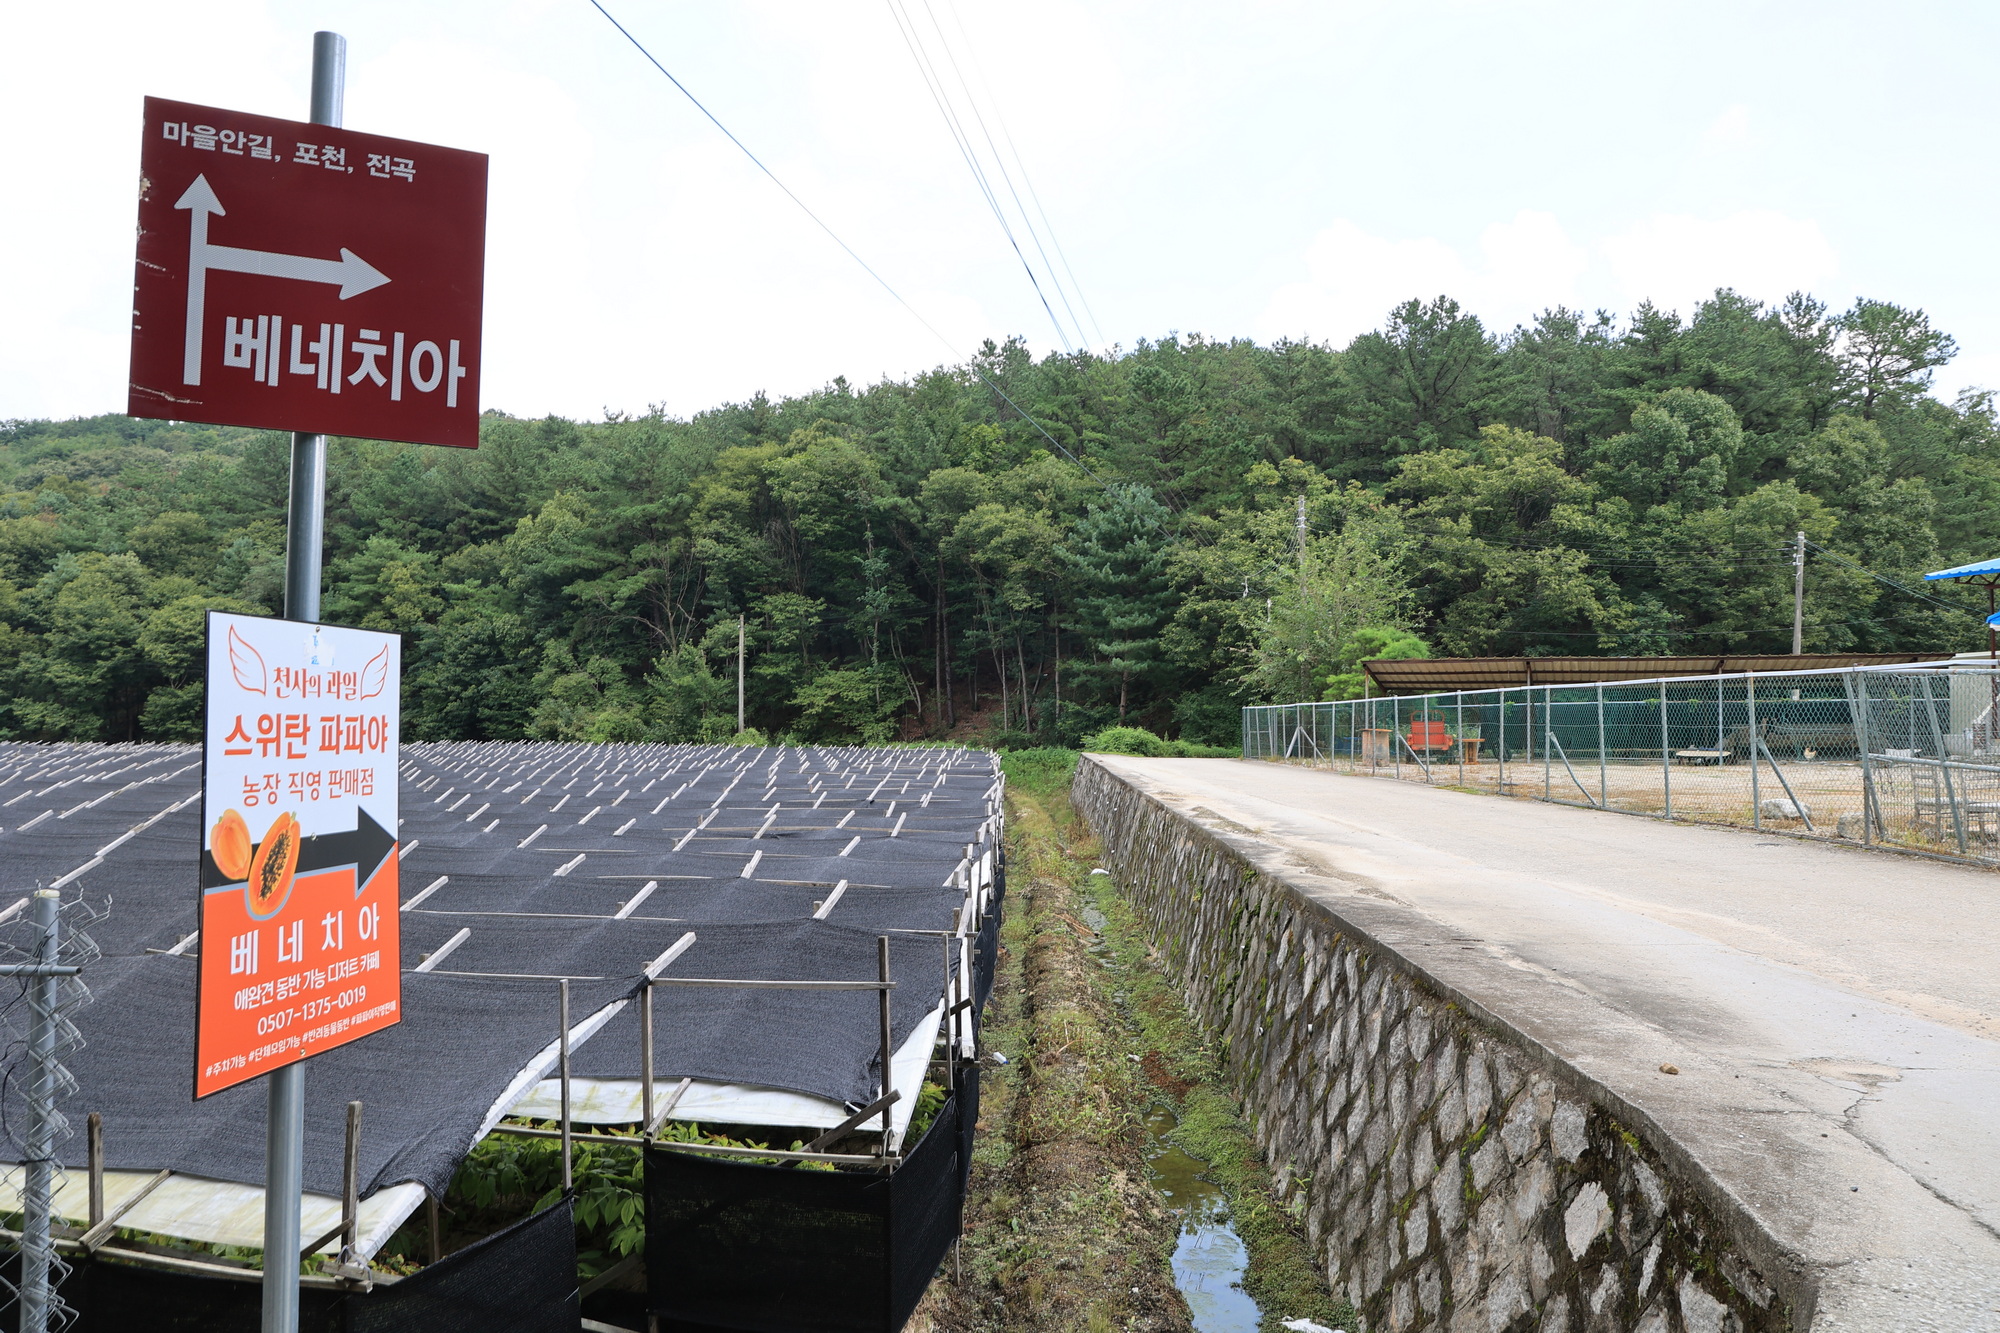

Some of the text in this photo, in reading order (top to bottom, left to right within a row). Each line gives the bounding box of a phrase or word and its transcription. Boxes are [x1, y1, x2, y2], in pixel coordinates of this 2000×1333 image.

[163, 121, 416, 182] 마을안길, 포천, 전곡
[224, 314, 466, 408] 베네치아
[273, 667, 357, 700] 천사의 과일
[224, 713, 388, 759] 스위탄 파파야
[242, 768, 374, 807] 농장 직영 판매점
[234, 950, 380, 1010] 애완견 동반 가능 디저트 카페
[257, 985, 367, 1035] 0507-1375-0019
[205, 1054, 247, 1078] #주차가능
[248, 1035, 301, 1062] #단체모임가능
[302, 1016, 350, 1043] #반려동물동반
